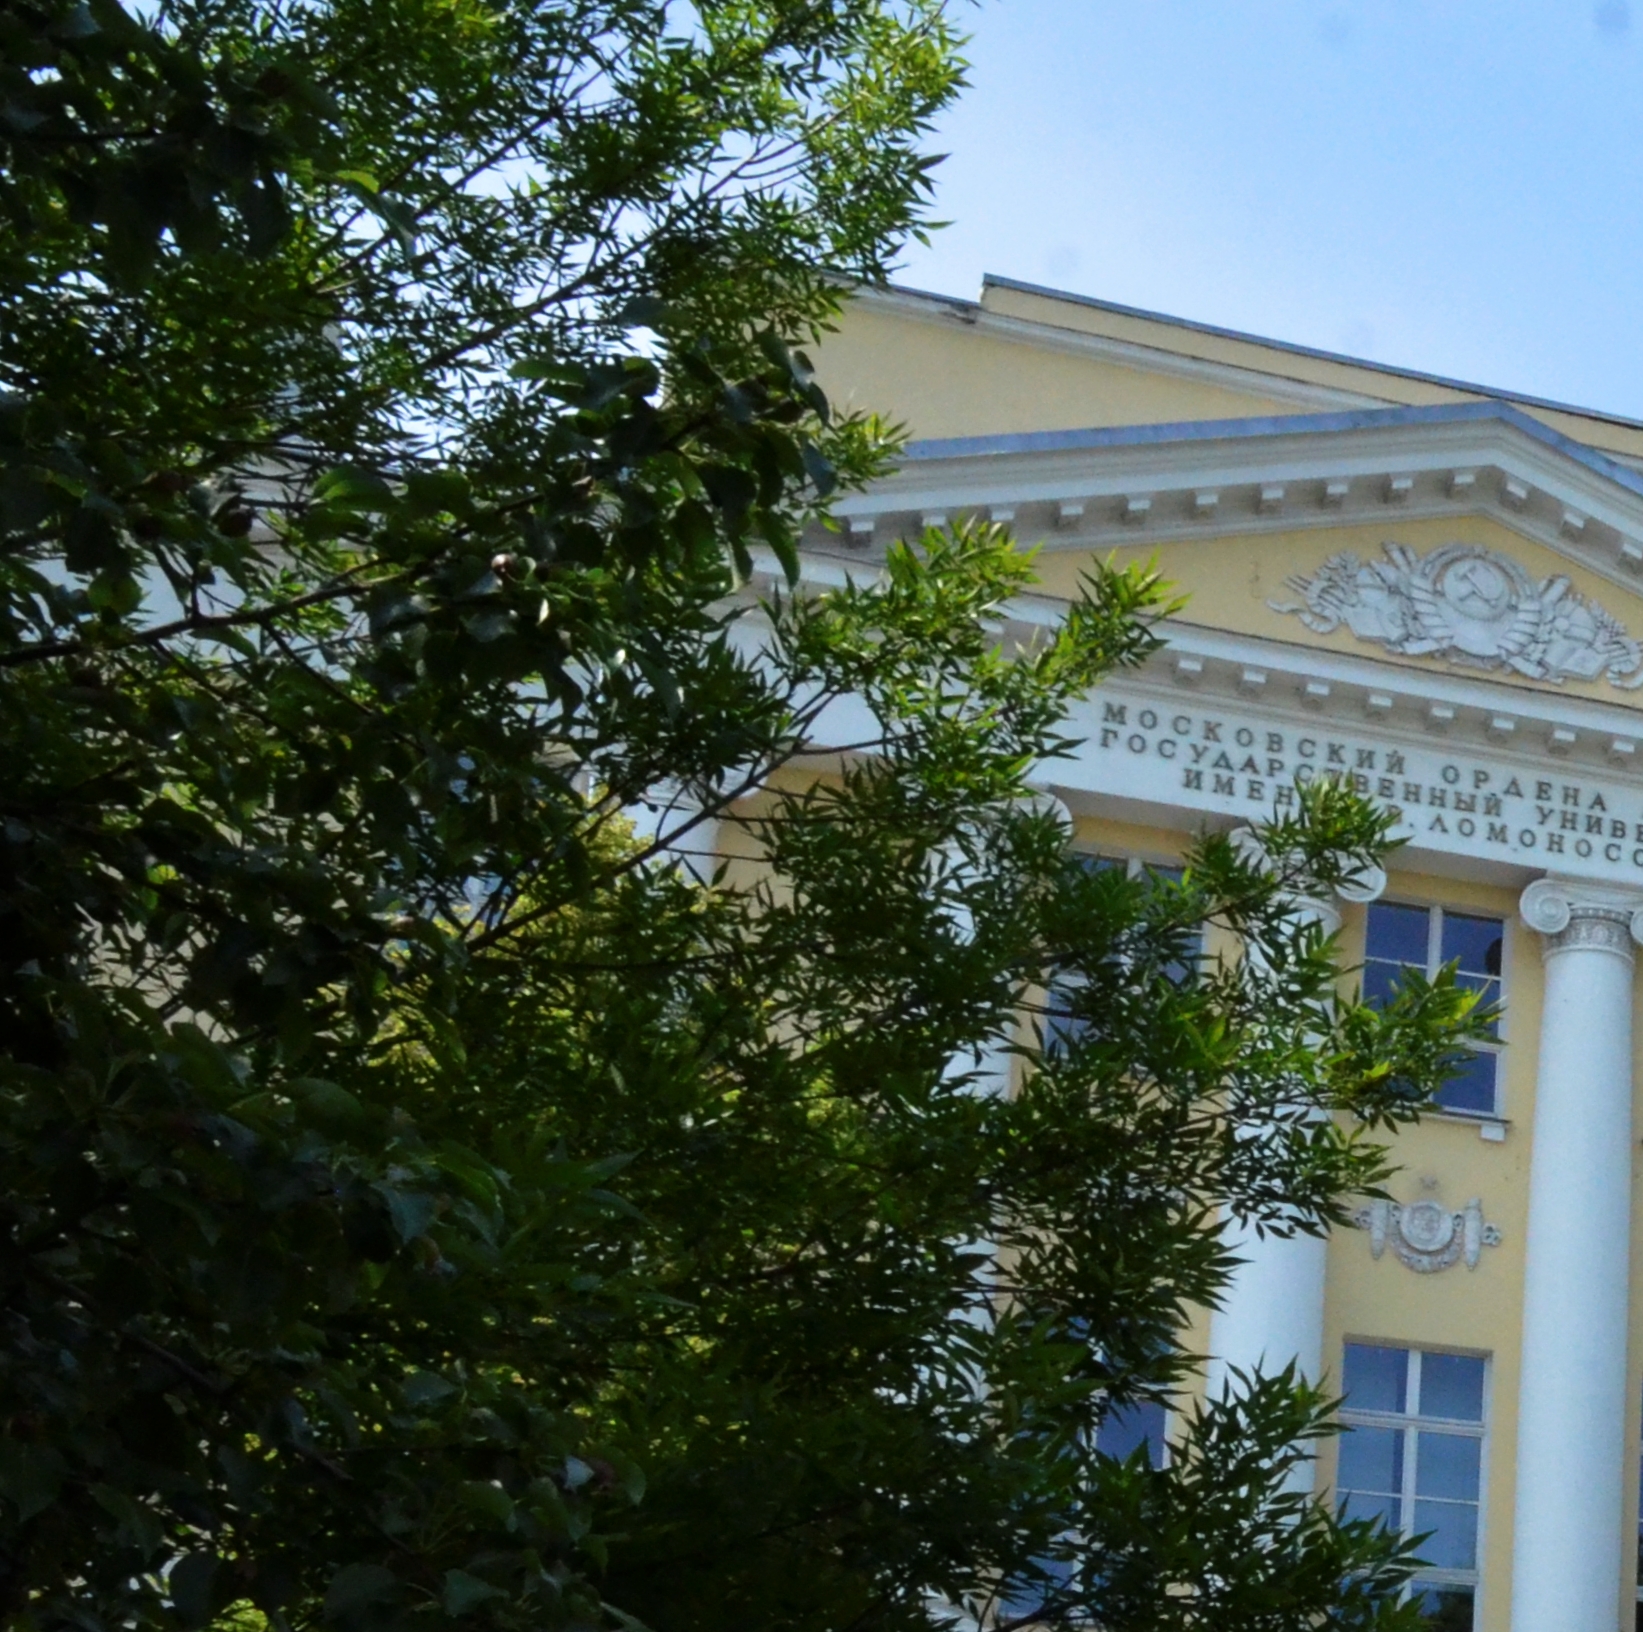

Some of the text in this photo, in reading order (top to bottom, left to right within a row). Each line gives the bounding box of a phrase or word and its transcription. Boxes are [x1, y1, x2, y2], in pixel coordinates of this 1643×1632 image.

[1102, 701, 1406, 775] МОСКОВСКИЙ
[1441, 764, 1607, 812] ОРДЕНА
[1182, 767, 1296, 807] ИМЕН
